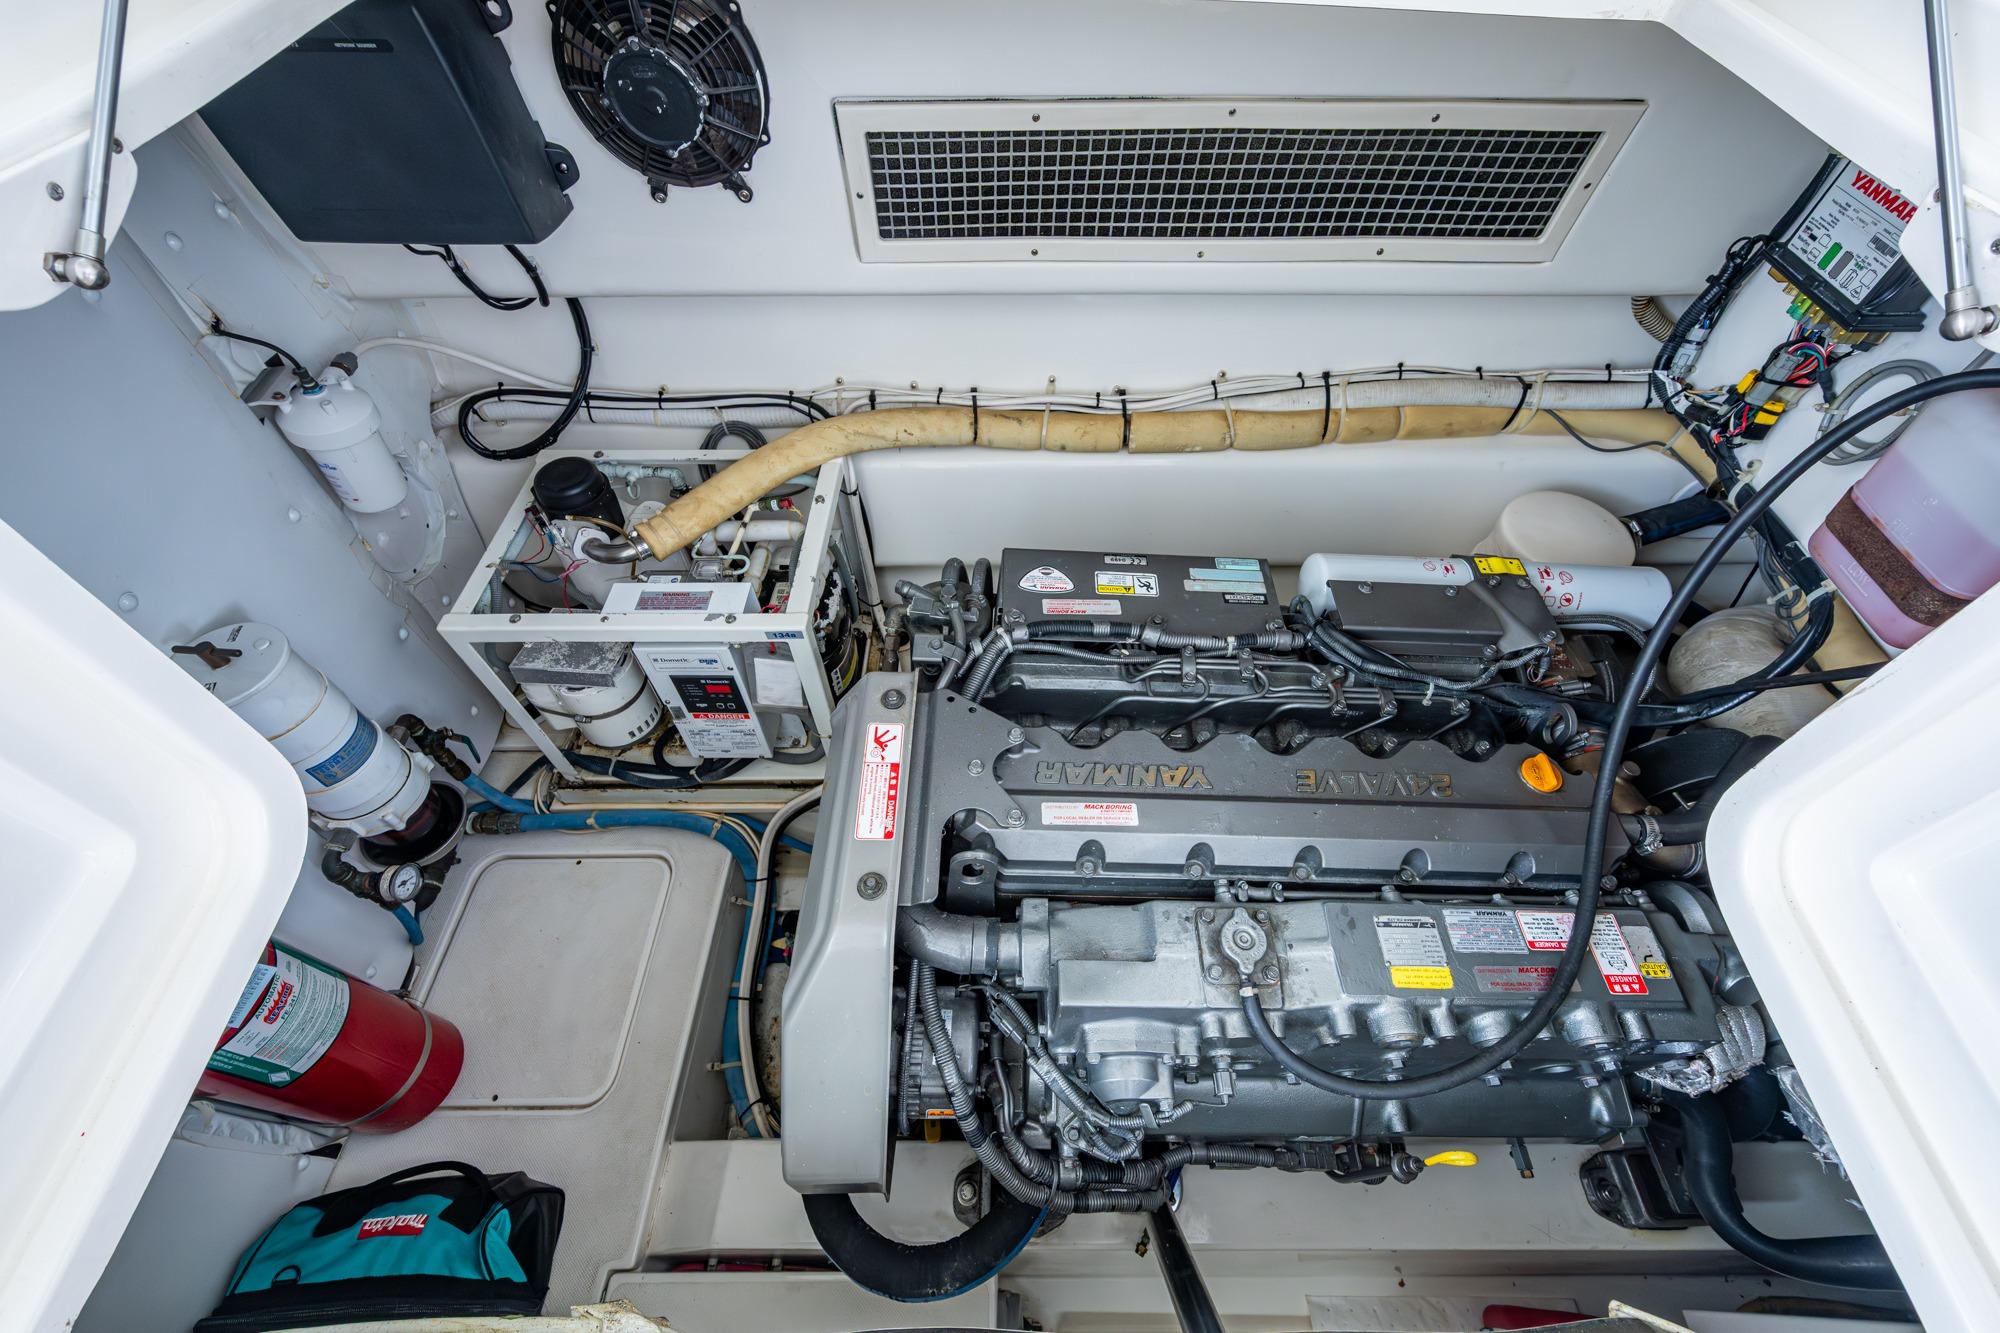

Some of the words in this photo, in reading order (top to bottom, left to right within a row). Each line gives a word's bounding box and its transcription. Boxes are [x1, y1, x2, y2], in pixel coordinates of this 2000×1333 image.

[1036, 761, 1213, 788] YANMAR
[255, 974, 281, 1020] AUTOMATIC
[362, 1214, 428, 1232] makita
